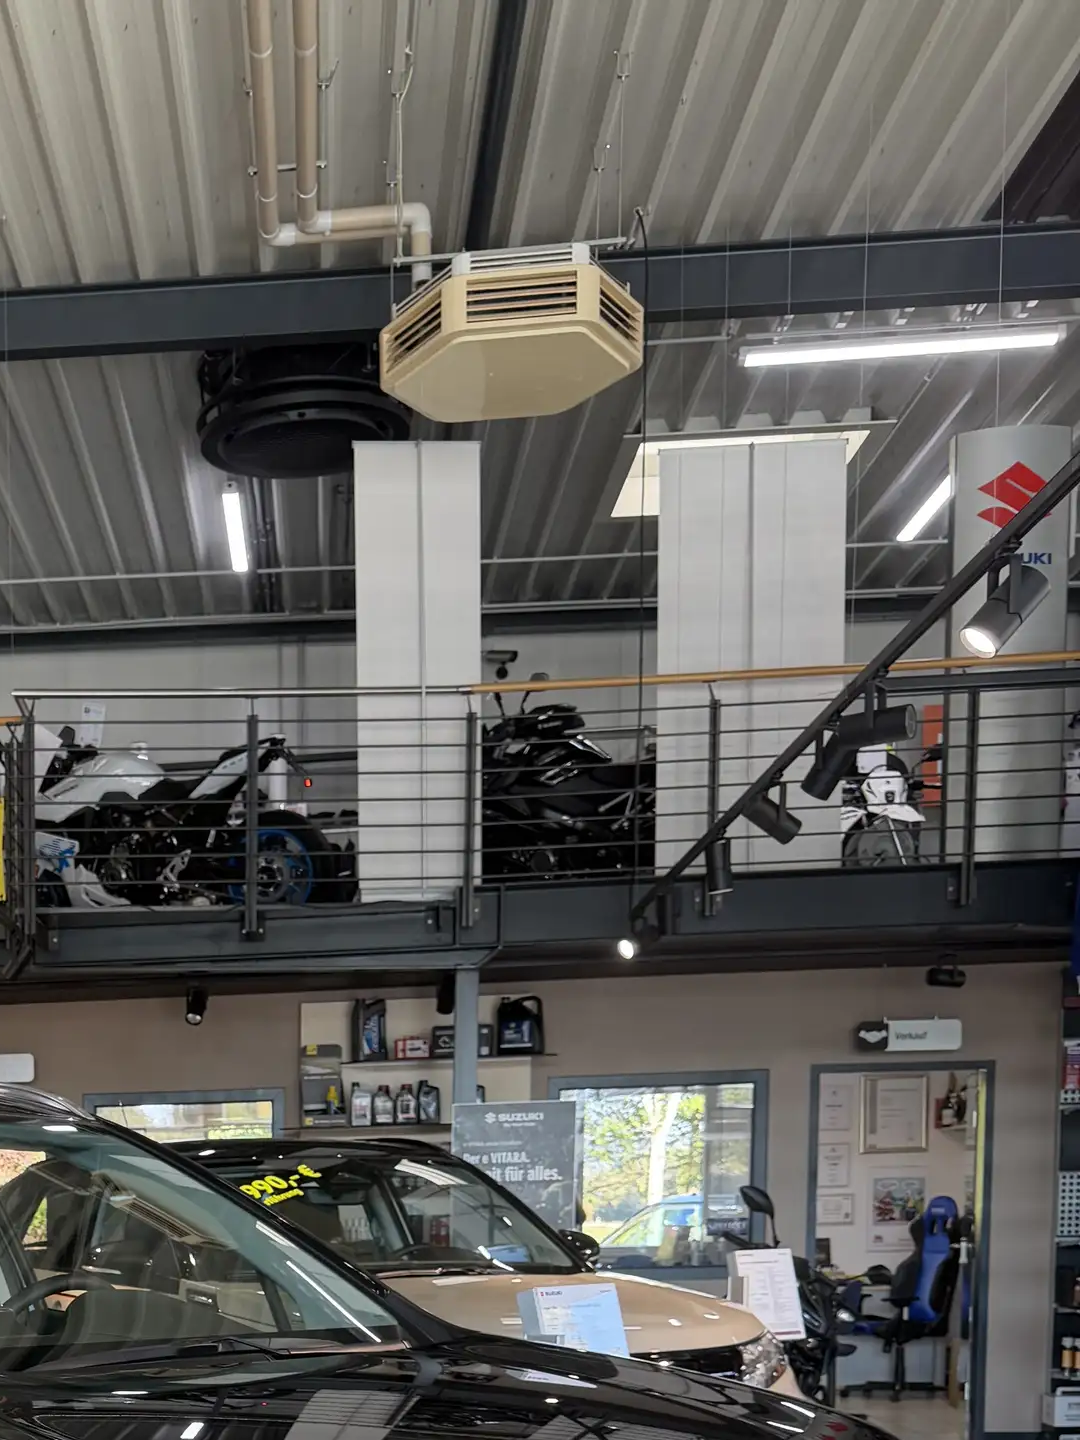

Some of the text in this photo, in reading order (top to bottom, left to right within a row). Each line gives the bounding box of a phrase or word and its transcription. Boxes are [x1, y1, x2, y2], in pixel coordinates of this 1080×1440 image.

[1021, 553, 1052, 565] UKI
[498, 1112, 545, 1122] SUZUKI
[505, 1165, 525, 1182] für
[527, 1165, 564, 1181] alles.
